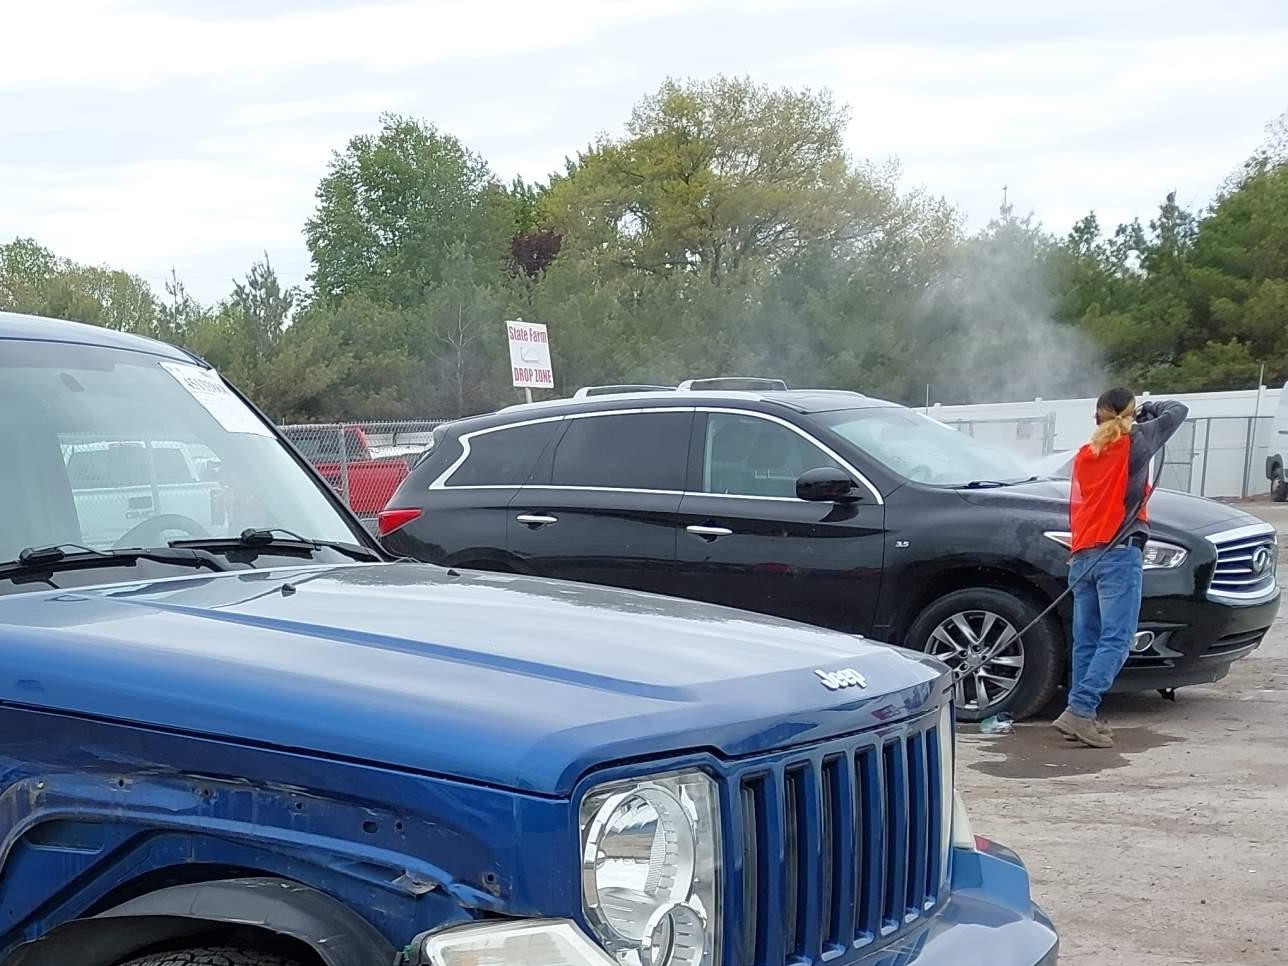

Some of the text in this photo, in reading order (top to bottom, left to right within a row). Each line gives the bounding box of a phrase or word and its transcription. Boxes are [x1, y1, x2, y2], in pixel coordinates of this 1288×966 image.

[509, 326, 547, 343] State Farm
[514, 368, 551, 383] DROP ZONE
[814, 668, 867, 690] Jeep
